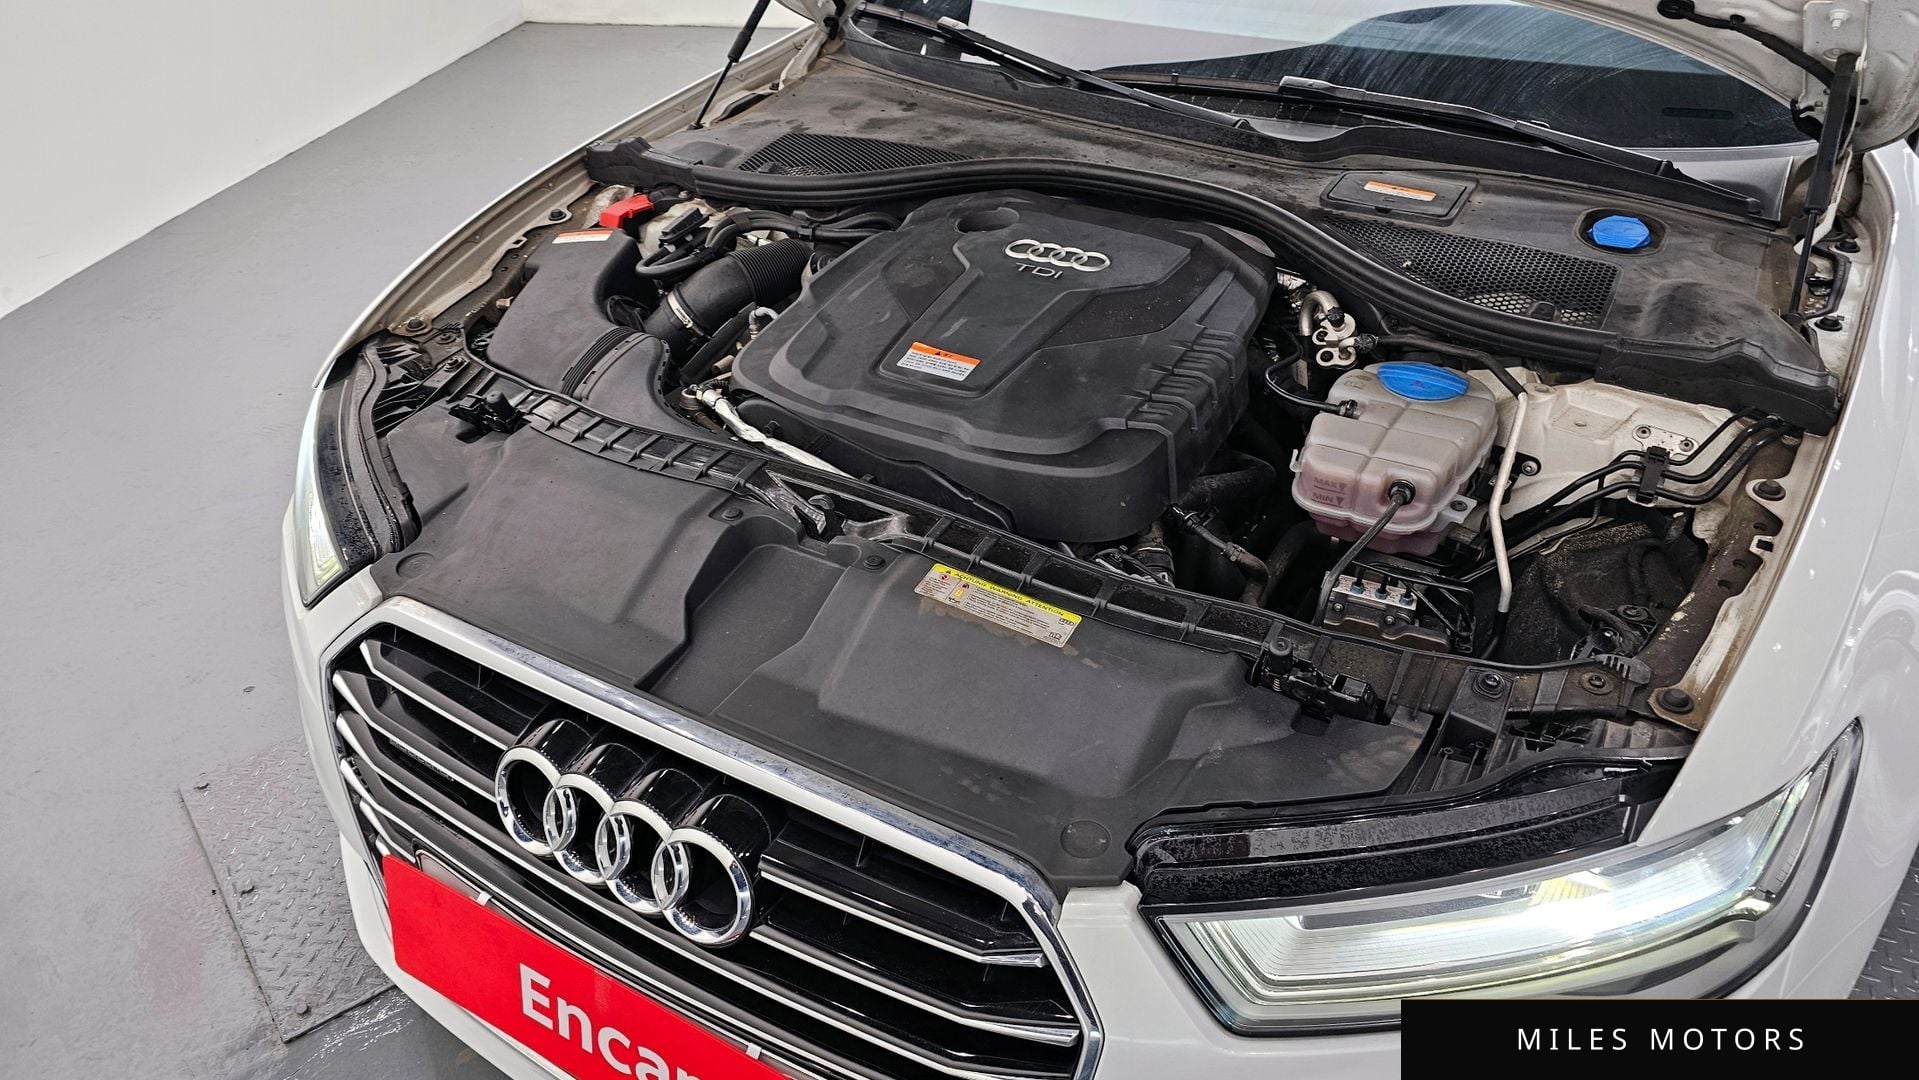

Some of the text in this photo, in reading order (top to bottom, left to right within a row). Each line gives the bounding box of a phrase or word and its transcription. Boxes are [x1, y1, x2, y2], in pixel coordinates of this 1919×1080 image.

[1015, 262, 1063, 279] TDI
[954, 572, 987, 587] ACHTUNG
[989, 585, 1023, 601] WARNING
[1025, 599, 1065, 616] ATTENTION
